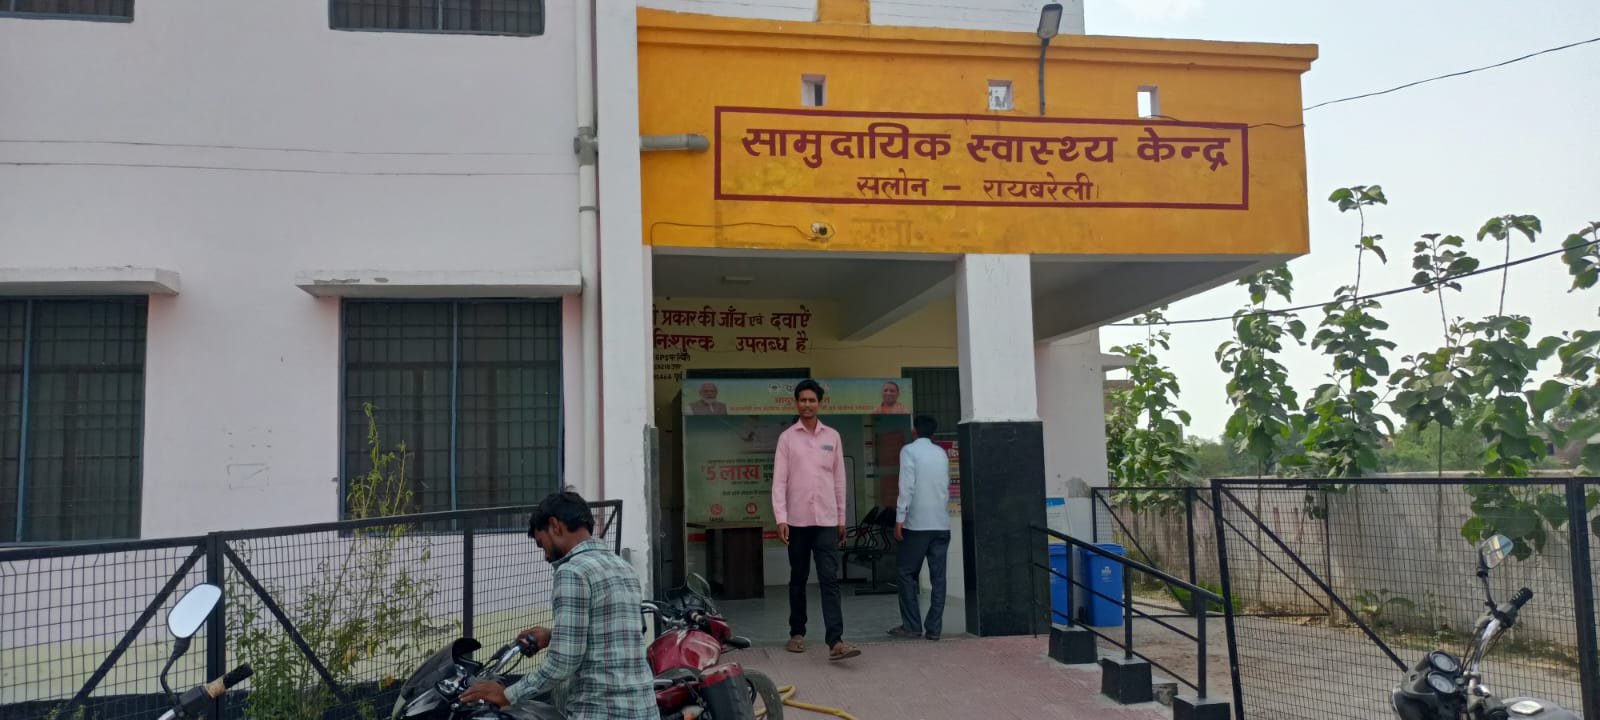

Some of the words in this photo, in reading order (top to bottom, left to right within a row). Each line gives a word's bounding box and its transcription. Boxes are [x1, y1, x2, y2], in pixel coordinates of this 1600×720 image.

[743, 122, 951, 168] सामुदायिक
[966, 133, 1117, 164] स्वास्थ्य
[1137, 127, 1231, 173] केन्द्र
[856, 168, 928, 198] सलोन
[736, 336, 790, 353] उपलब्ध
[719, 464, 761, 481] लाख
